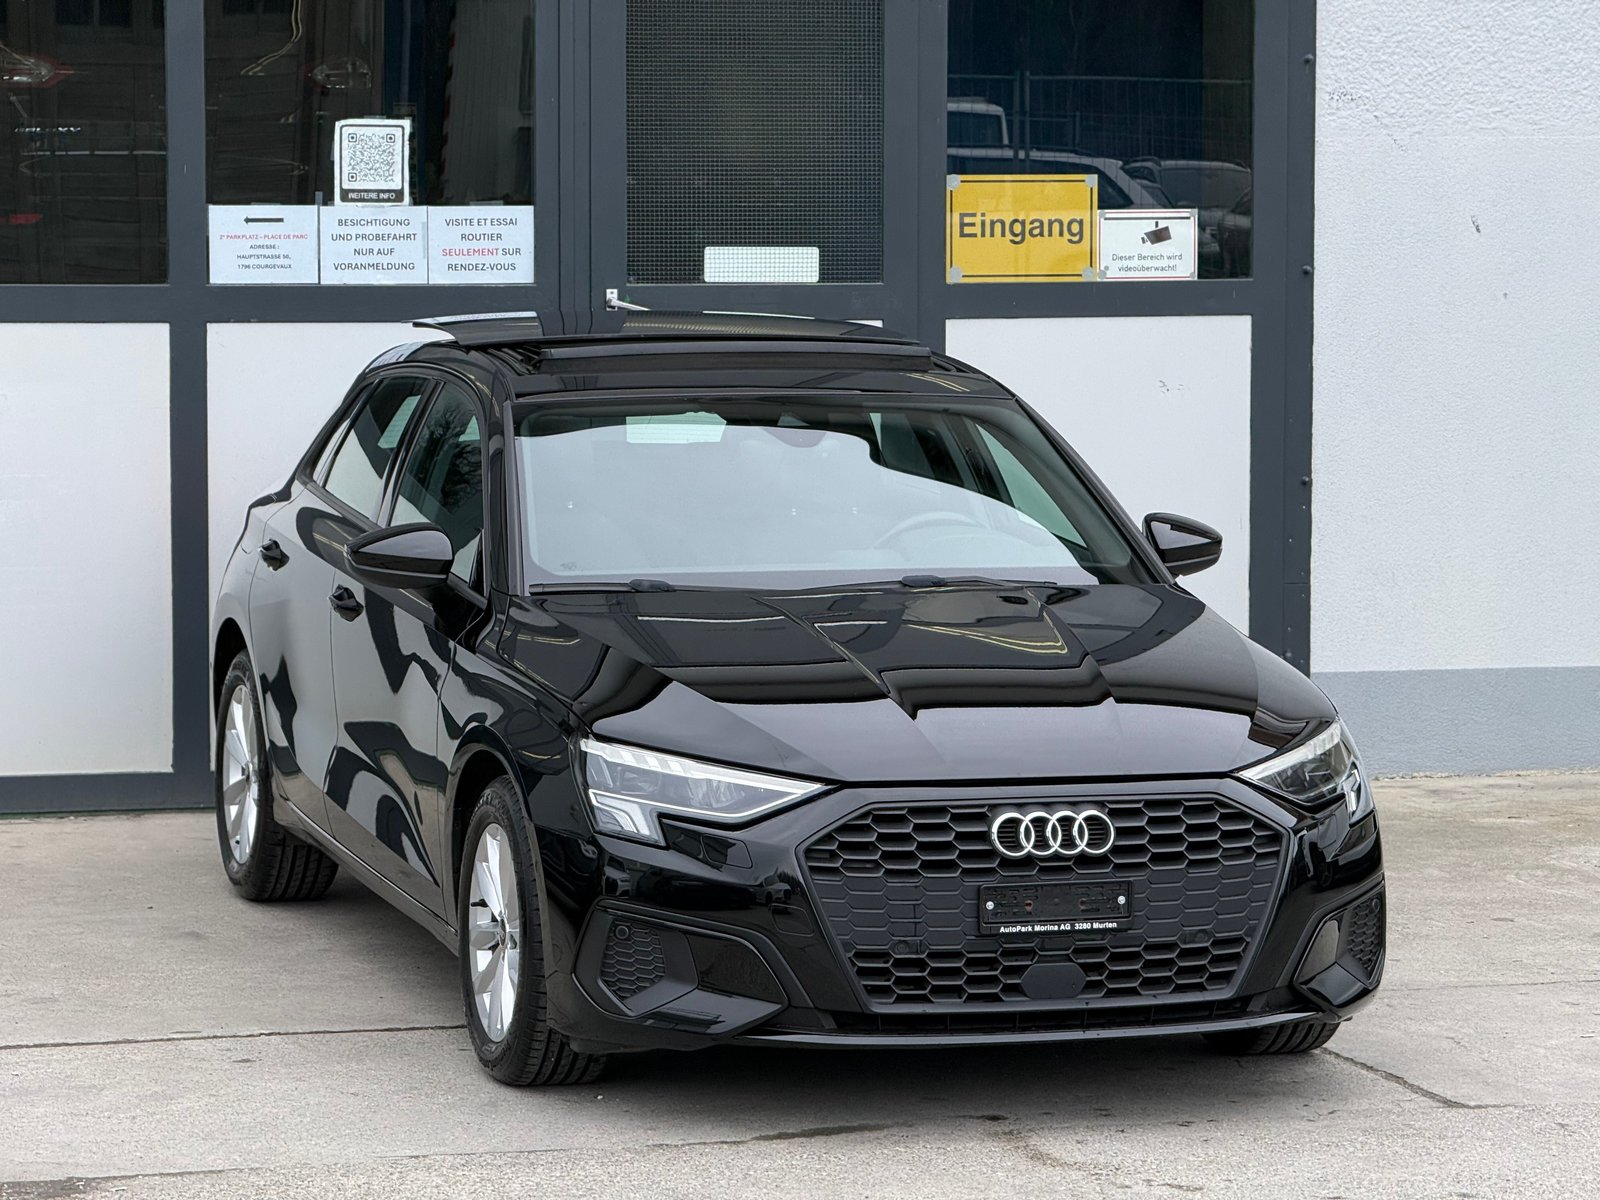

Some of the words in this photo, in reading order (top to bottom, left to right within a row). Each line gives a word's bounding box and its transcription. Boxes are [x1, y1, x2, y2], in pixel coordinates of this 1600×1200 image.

[337, 218, 411, 227] BESICHTIGUNG
[444, 218, 475, 227] VISITE
[476, 218, 488, 226] ET
[490, 217, 518, 226] ESSAI
[958, 211, 1085, 245] Eingang
[331, 233, 353, 241] UND
[355, 233, 418, 241] PROBEFAHRT
[460, 233, 503, 242] ROUTIER
[353, 248, 375, 256] NUR
[376, 248, 395, 256] AUF
[441, 248, 500, 257] SEULEMENT
[501, 247, 522, 256] SUR
[1111, 253, 1136, 262] Dieser
[1137, 253, 1165, 261] Bereich
[1166, 253, 1183, 261] wird
[333, 262, 416, 271] VORANMELDUNG
[447, 262, 517, 271] RENDEZ-VOUS
[1117, 263, 1177, 272] videoüberwacht!
[999, 925, 1033, 934] AutoPark
[1034, 924, 1058, 932] Morina
[1059, 923, 1071, 931] AG
[1074, 922, 1092, 930] 3280
[1092, 921, 1118, 929] Murten
